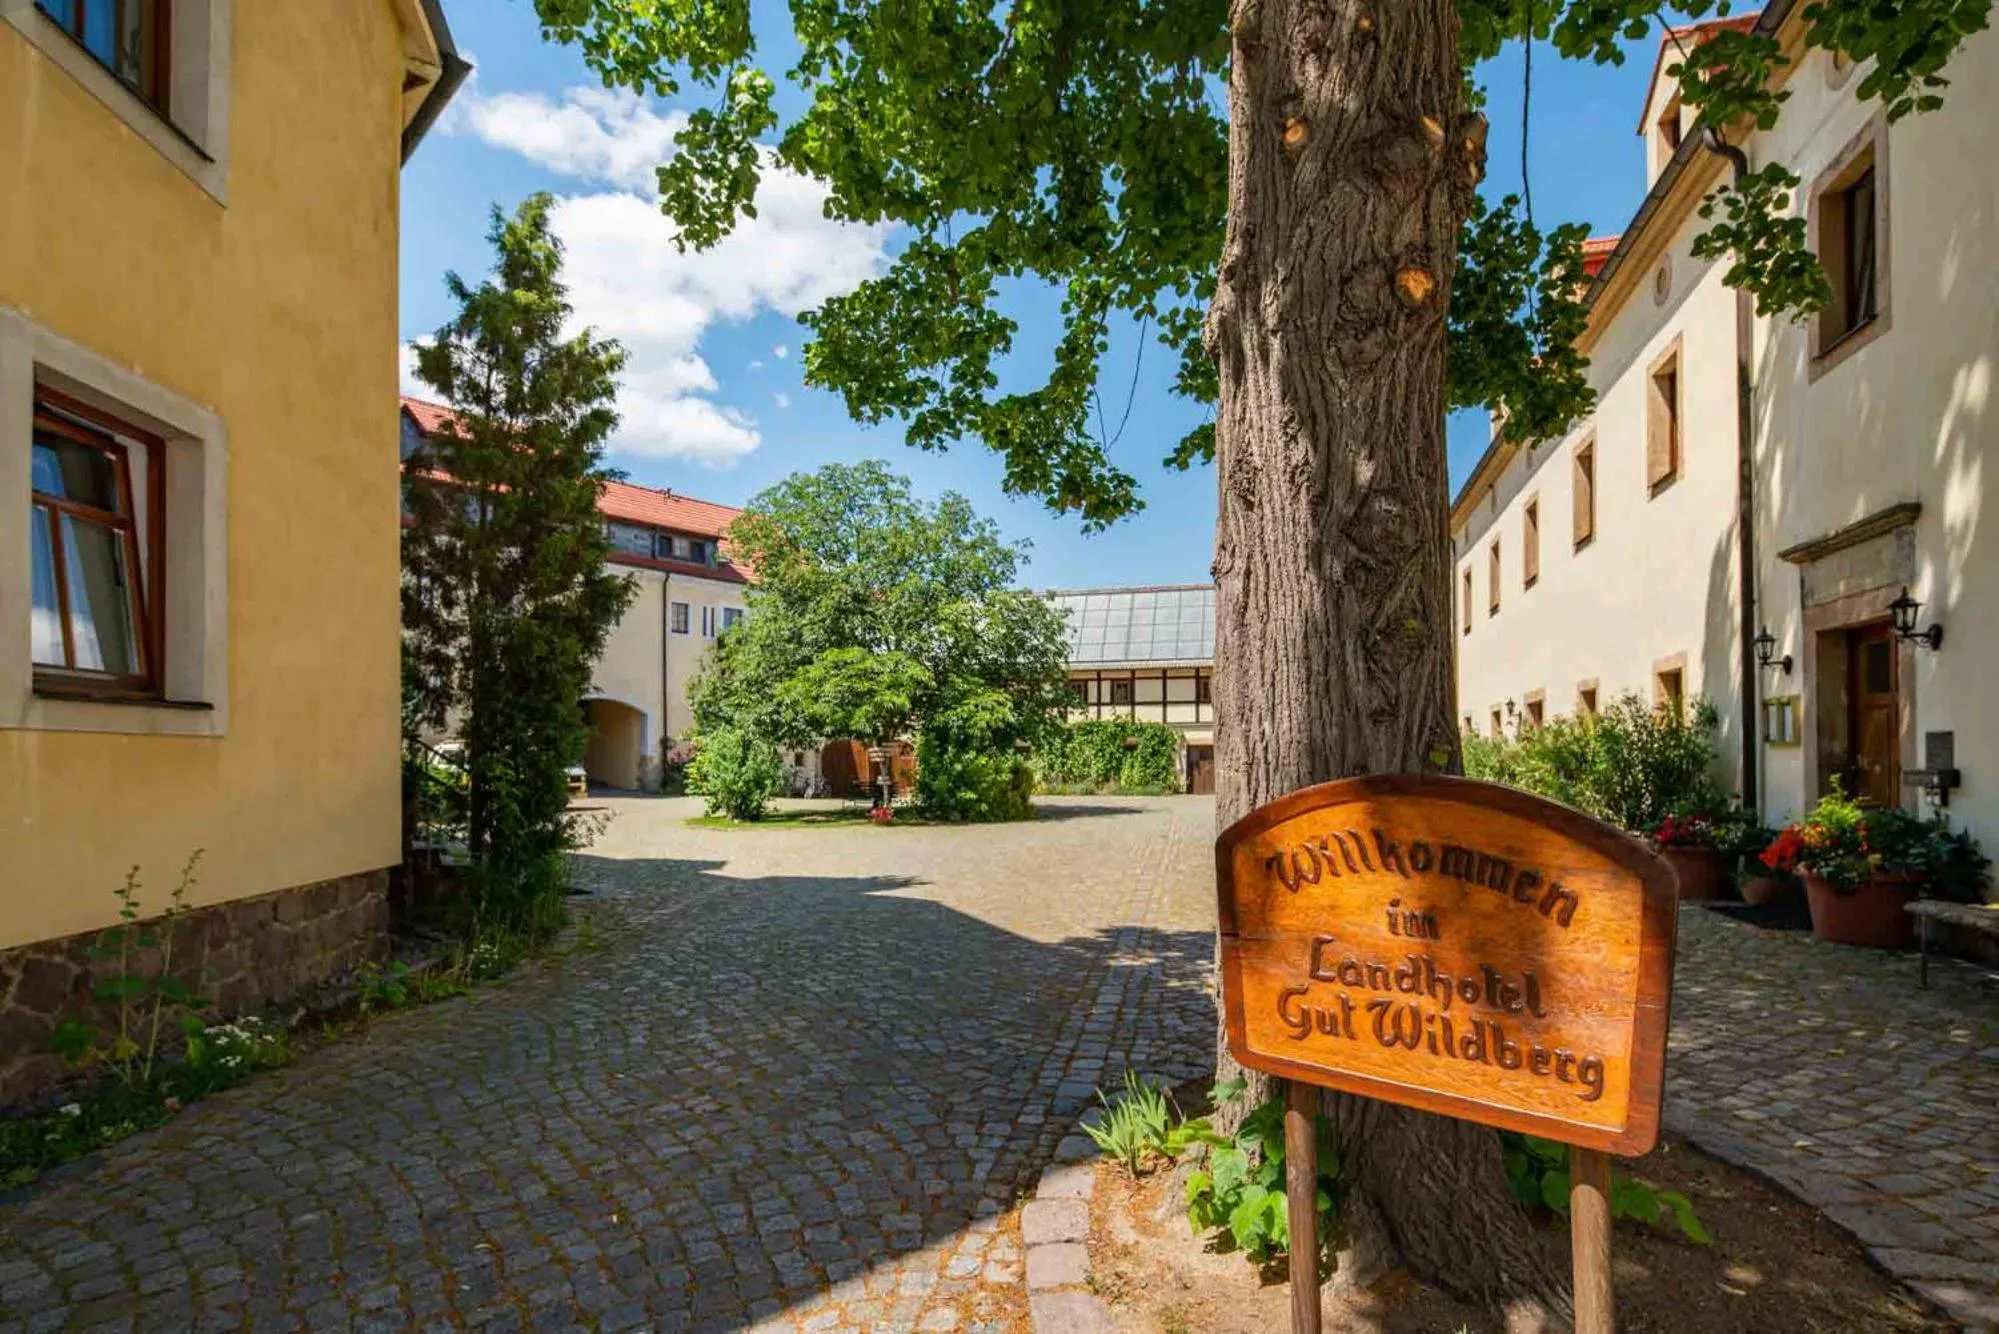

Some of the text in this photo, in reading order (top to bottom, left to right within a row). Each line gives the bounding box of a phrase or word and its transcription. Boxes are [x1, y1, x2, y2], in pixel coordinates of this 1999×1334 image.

[1264, 827, 1580, 928] Willkommen
[1385, 898, 1440, 940] im
[1309, 934, 1547, 1019] Landhotel
[1277, 984, 1604, 1101] Gut Wildberg
